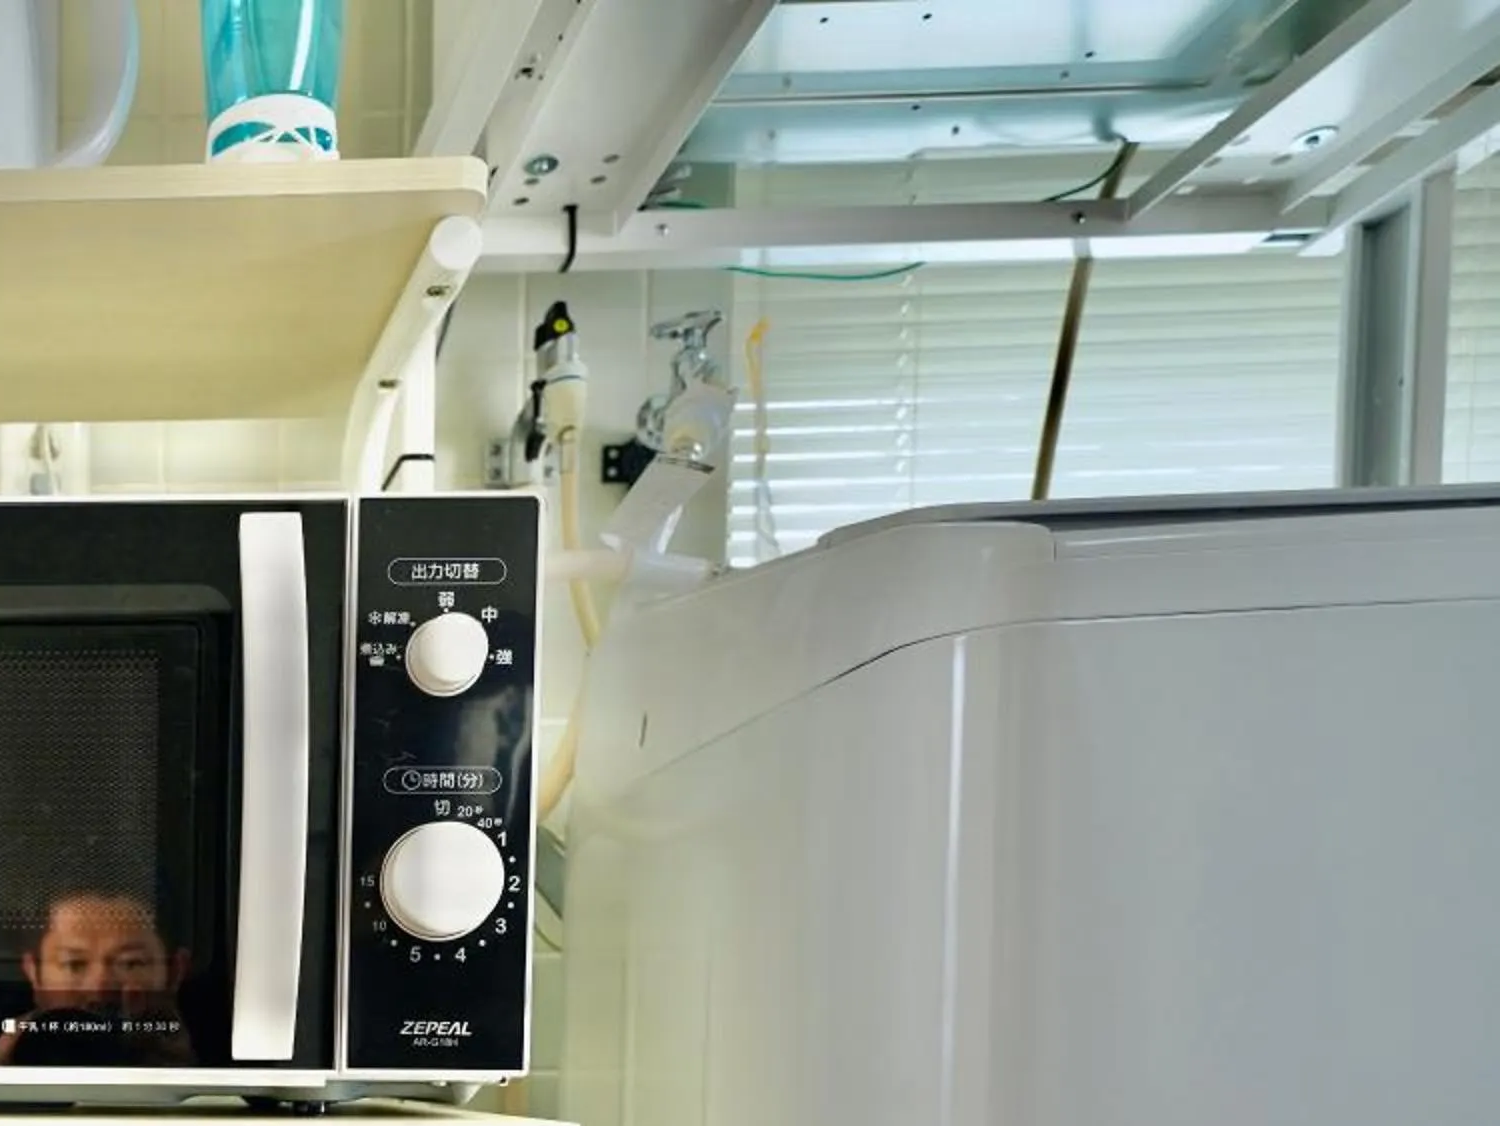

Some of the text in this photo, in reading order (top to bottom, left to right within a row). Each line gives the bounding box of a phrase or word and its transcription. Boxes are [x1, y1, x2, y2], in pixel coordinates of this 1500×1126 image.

[411, 563, 480, 580] 出力切替
[481, 606, 498, 623] 中
[496, 649, 513, 665] 強
[422, 772, 484, 789] 時間(分)
[434, 799, 450, 817] 切
[498, 832, 508, 847] 1
[360, 876, 375, 887] 15
[508, 876, 521, 891] 2
[372, 920, 387, 932] 10
[495, 918, 507, 934] 3
[409, 946, 421, 962] 5
[455, 947, 467, 963] 4
[400, 1020, 473, 1036] ZEPEAL
